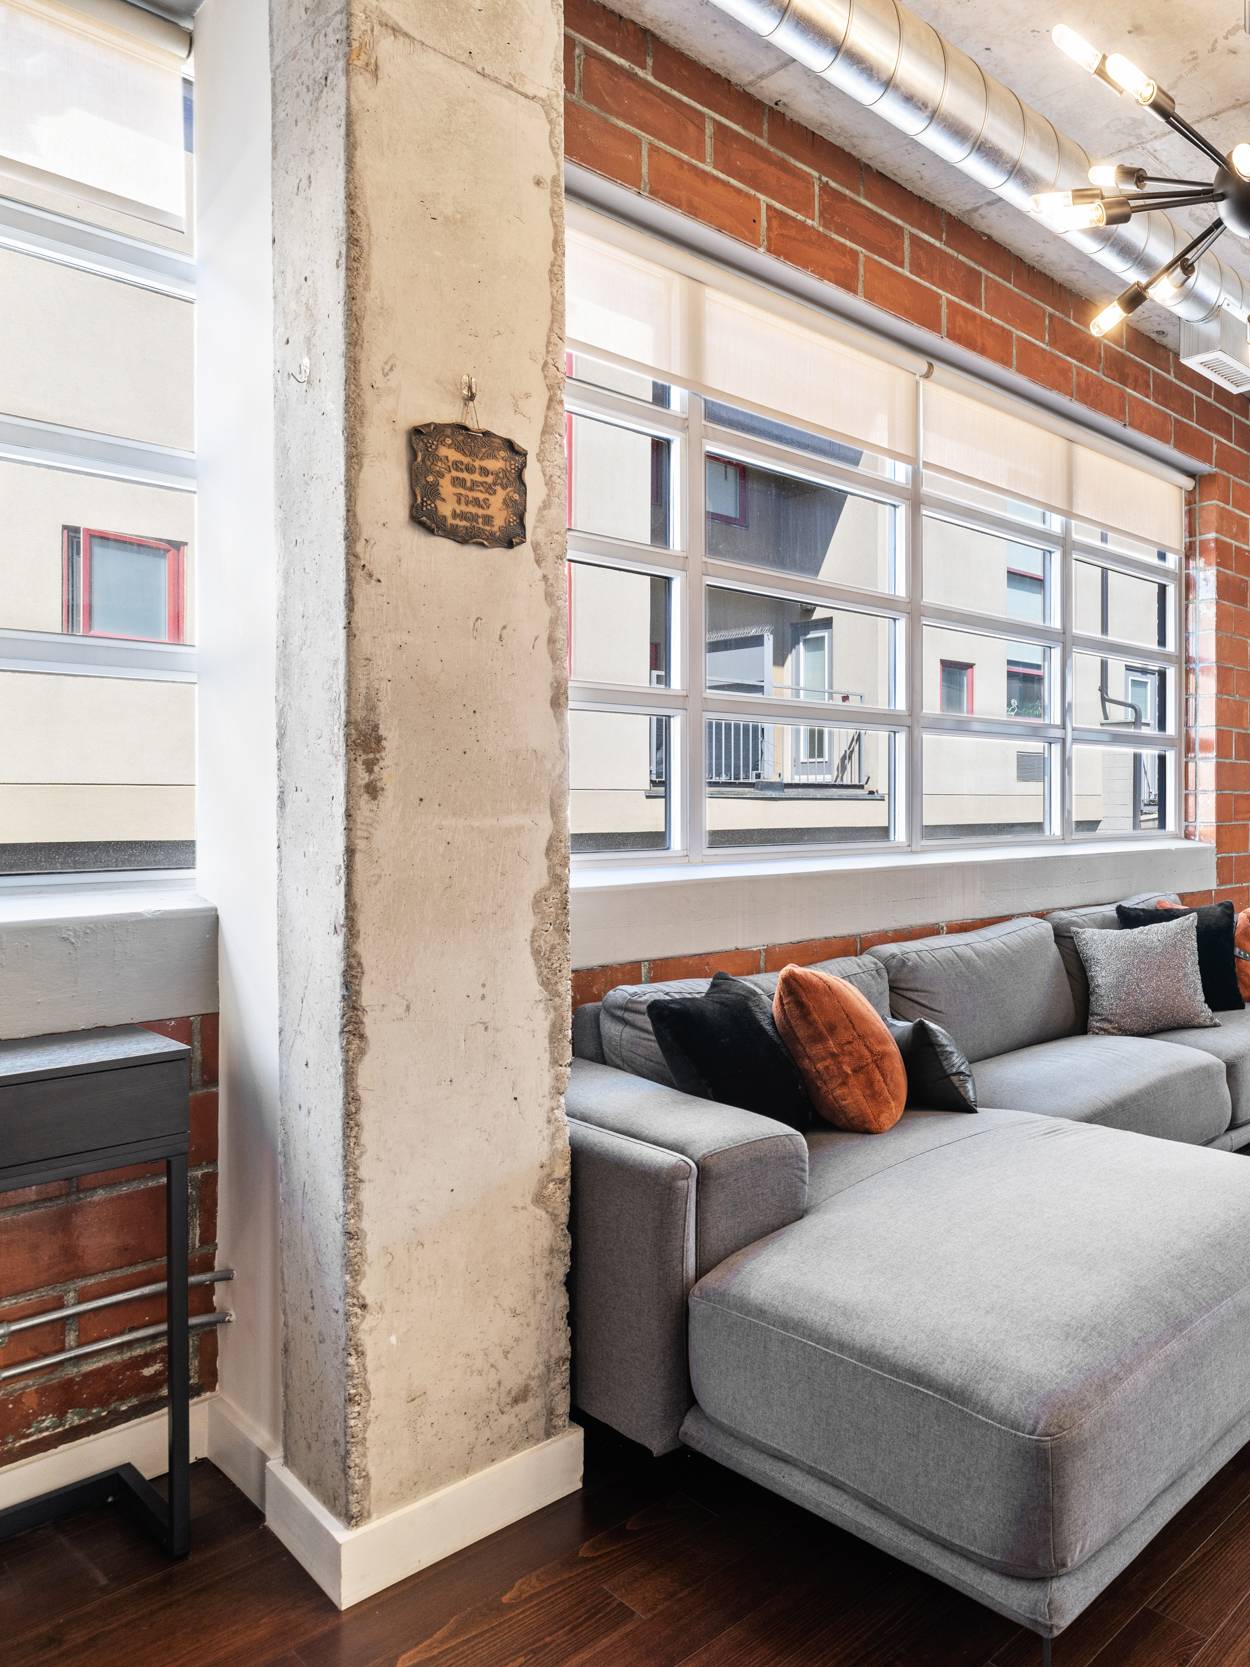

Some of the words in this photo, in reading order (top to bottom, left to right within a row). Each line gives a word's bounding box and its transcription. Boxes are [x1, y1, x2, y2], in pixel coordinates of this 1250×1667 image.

[452, 461, 490, 477] GOD
[451, 475, 496, 496] BLESS
[453, 492, 491, 510] THIS
[451, 507, 495, 527] HOME
